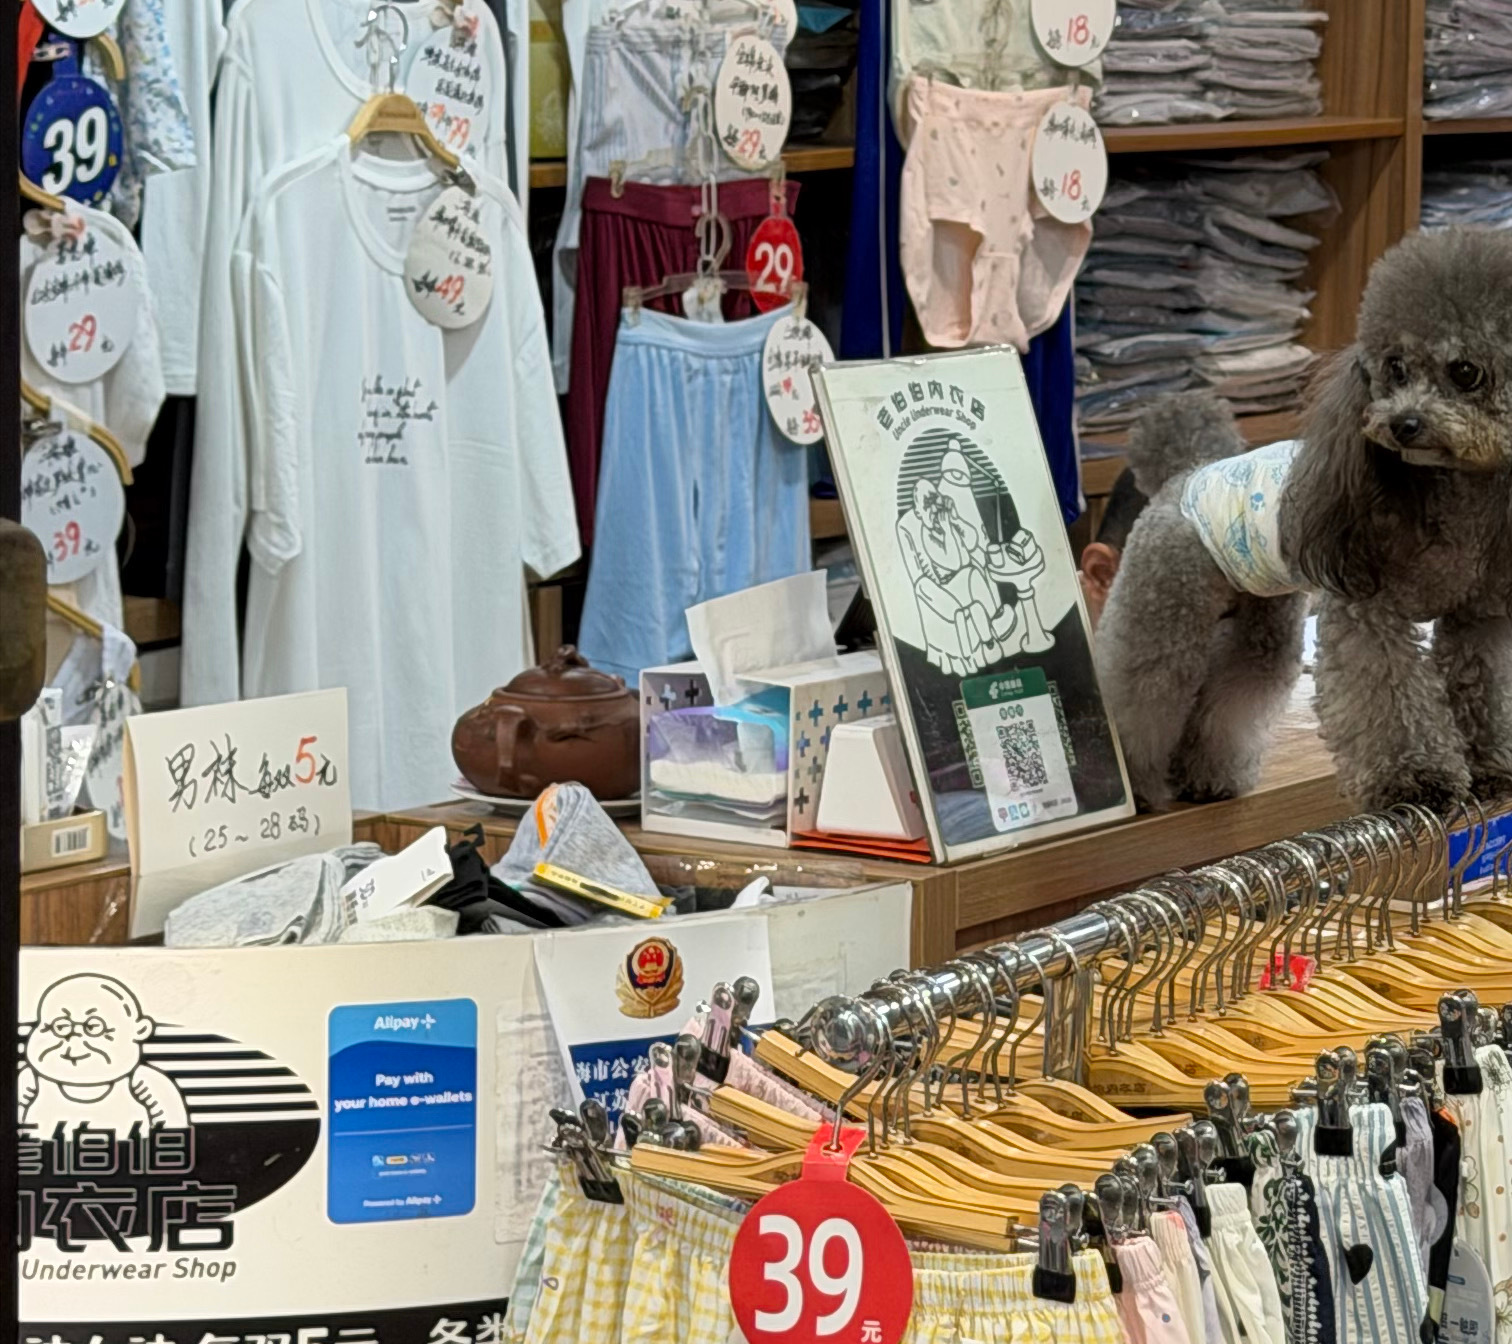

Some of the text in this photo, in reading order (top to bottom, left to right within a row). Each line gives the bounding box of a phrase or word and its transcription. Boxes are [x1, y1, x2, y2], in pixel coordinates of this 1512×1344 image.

[1066, 14, 1091, 46] 18
[42, 106, 108, 195] 39
[1061, 169, 1082, 201] 18
[755, 242, 794, 295] 29
[892, 404, 977, 441] Uncle Underwear Shop
[375, 1071, 434, 1088] Pay with
[334, 1090, 473, 1113] your home e-wallets
[22, 1257, 237, 1283] Underwear Shop
[755, 1214, 883, 1344] 39元
